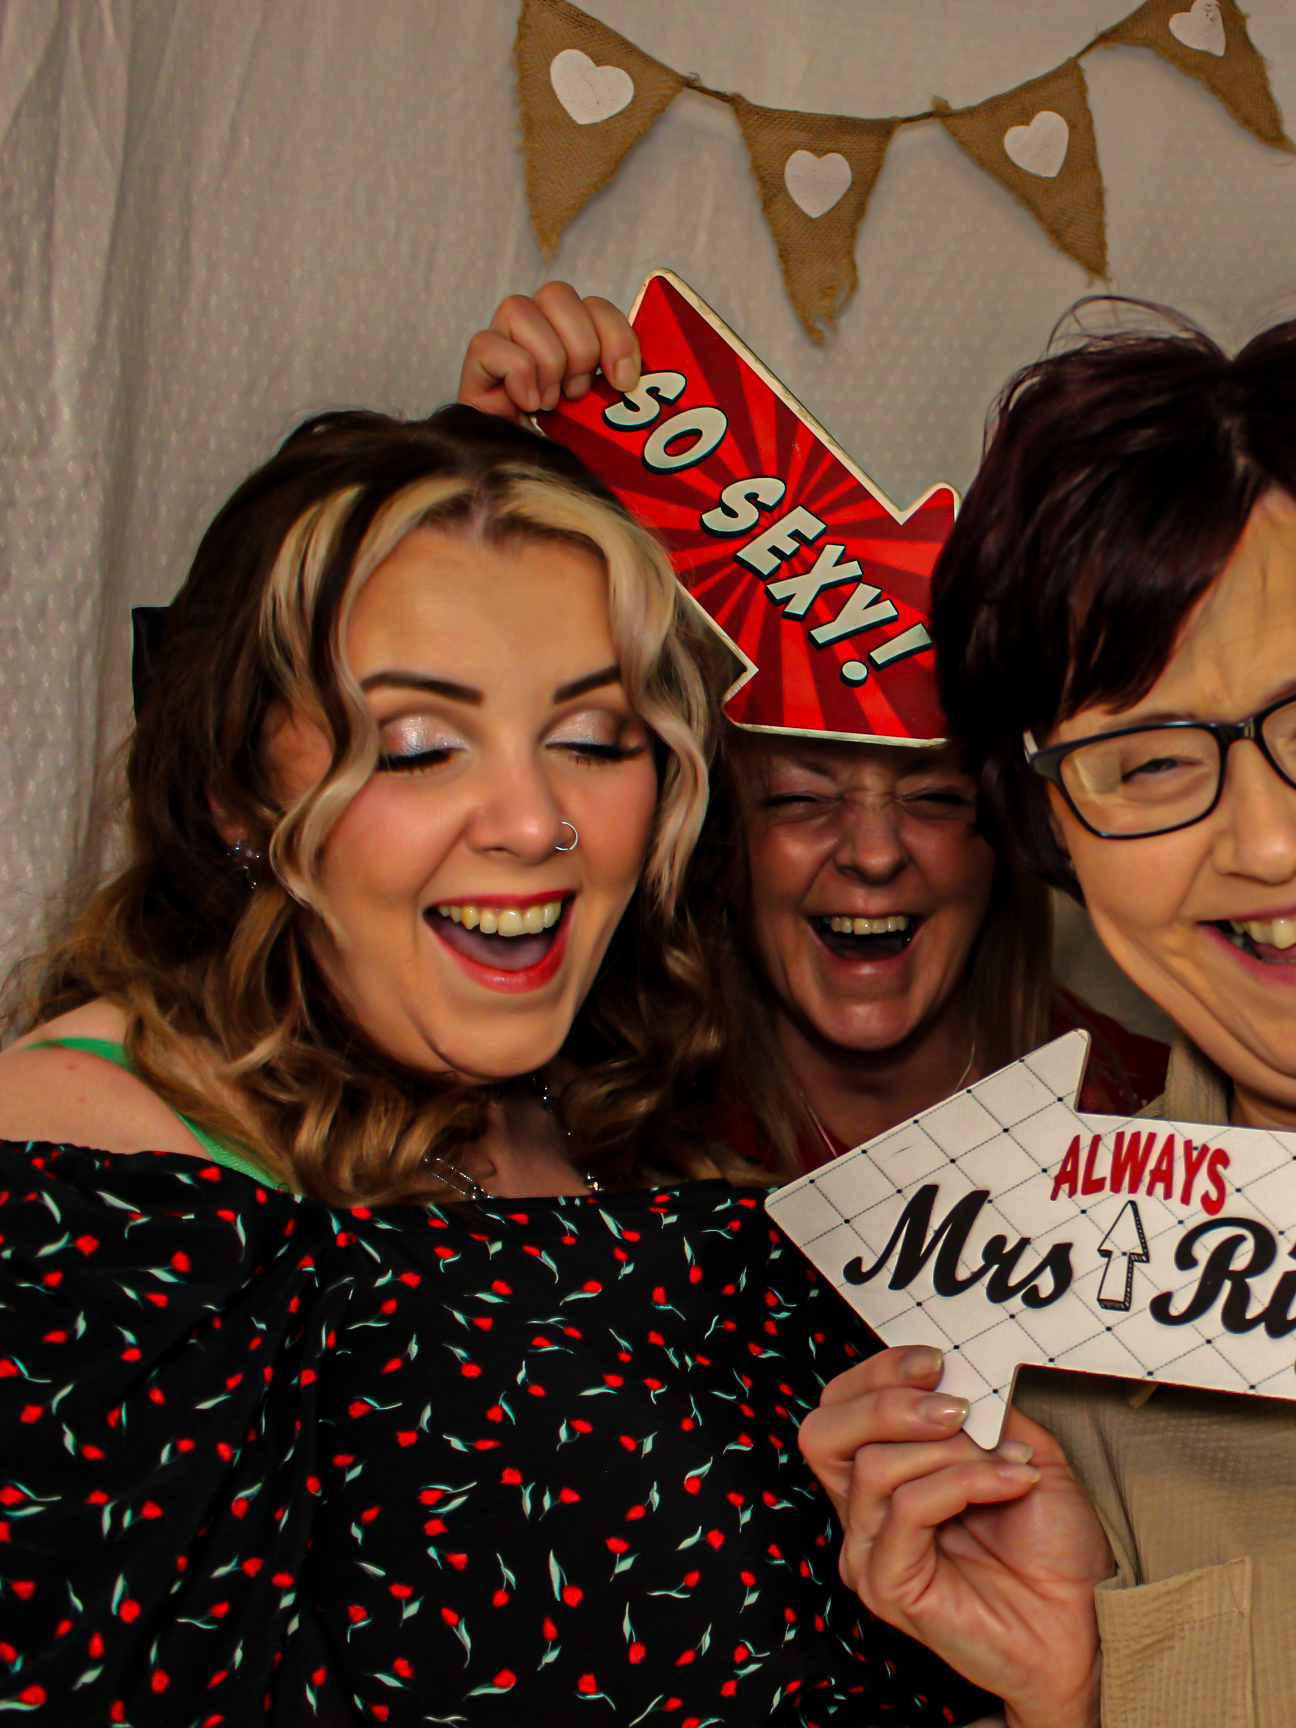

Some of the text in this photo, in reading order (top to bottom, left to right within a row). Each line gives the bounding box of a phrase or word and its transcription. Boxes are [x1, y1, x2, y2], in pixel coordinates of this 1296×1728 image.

[602, 371, 932, 687] SO SEXY!
[1051, 1130, 1230, 1215] ALWAYS
[843, 1185, 1073, 1308] Mrs
